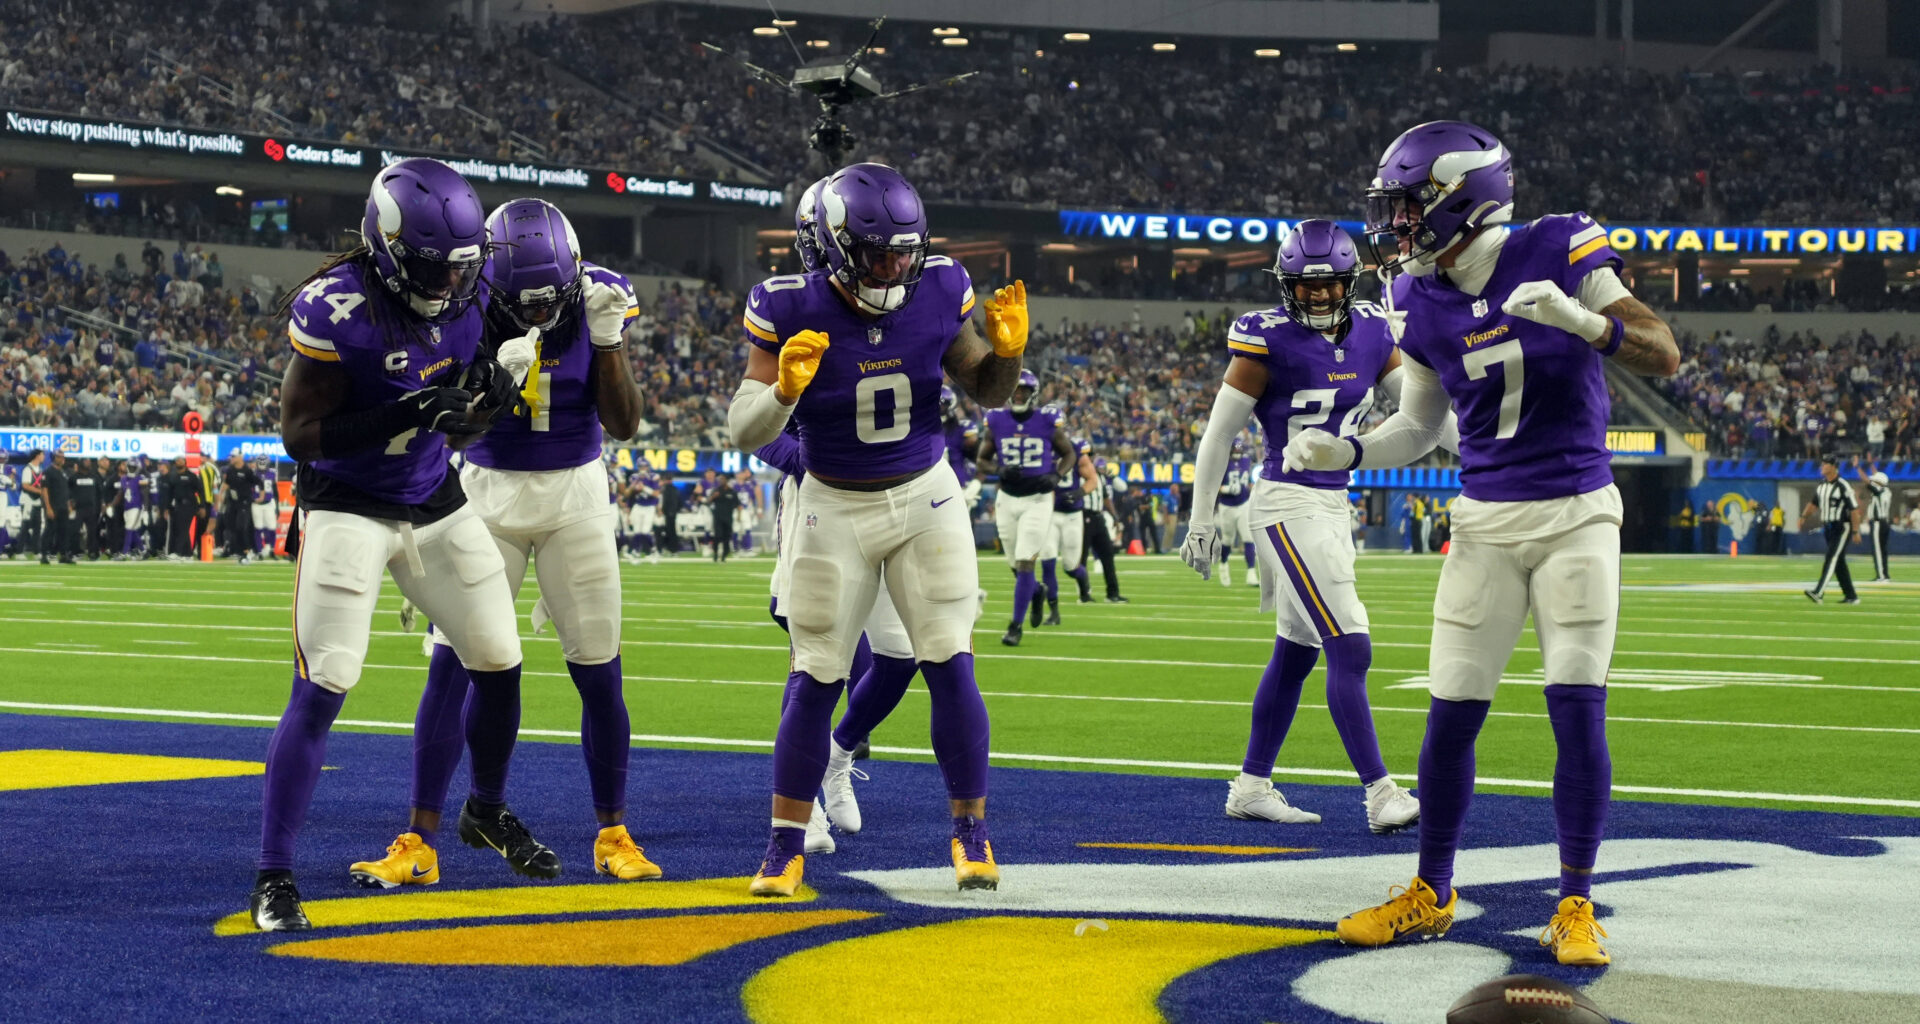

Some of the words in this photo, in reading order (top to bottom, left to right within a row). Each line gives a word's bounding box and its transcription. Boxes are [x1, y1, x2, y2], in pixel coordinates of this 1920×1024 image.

[6, 112, 49, 134] Never
[50, 119, 81, 140] stop
[84, 122, 140, 147] pushing
[143, 127, 187, 148] what's
[189, 134, 244, 154] possible
[286, 144, 330, 163] Cedars
[331, 147, 362, 166] Sinai
[498, 163, 537, 182] what's
[539, 168, 588, 187] possible
[626, 176, 666, 194] Cedars
[667, 180, 693, 197] Sinai
[710, 181, 743, 200] Never
[744, 187, 768, 204] stop
[1101, 215, 1297, 241] WELCOM
[1609, 228, 1738, 251] OYAL
[1763, 229, 1904, 252] TOUR
[763, 275, 806, 293] 0
[304, 277, 366, 325] 44
[1463, 325, 1509, 349] Vikings
[385, 351, 408, 371] C
[418, 357, 453, 381] Vikings
[857, 358, 902, 374] Vikings
[1327, 372, 1357, 382] Vikings
[1462, 339, 1524, 440] 7
[856, 372, 912, 444] 0
[1288, 387, 1374, 444] 24
[189, 417, 200, 432] 0
[10, 434, 50, 451] 12:08
[57, 435, 81, 452] :25
[89, 438, 107, 451] 1st
[111, 438, 121, 451] &
[125, 438, 141, 452] 10
[241, 442, 287, 456] RAMS
[1001, 437, 1044, 468] 52
[1605, 431, 1656, 453] STADIUM
[616, 449, 697, 473] AMS
